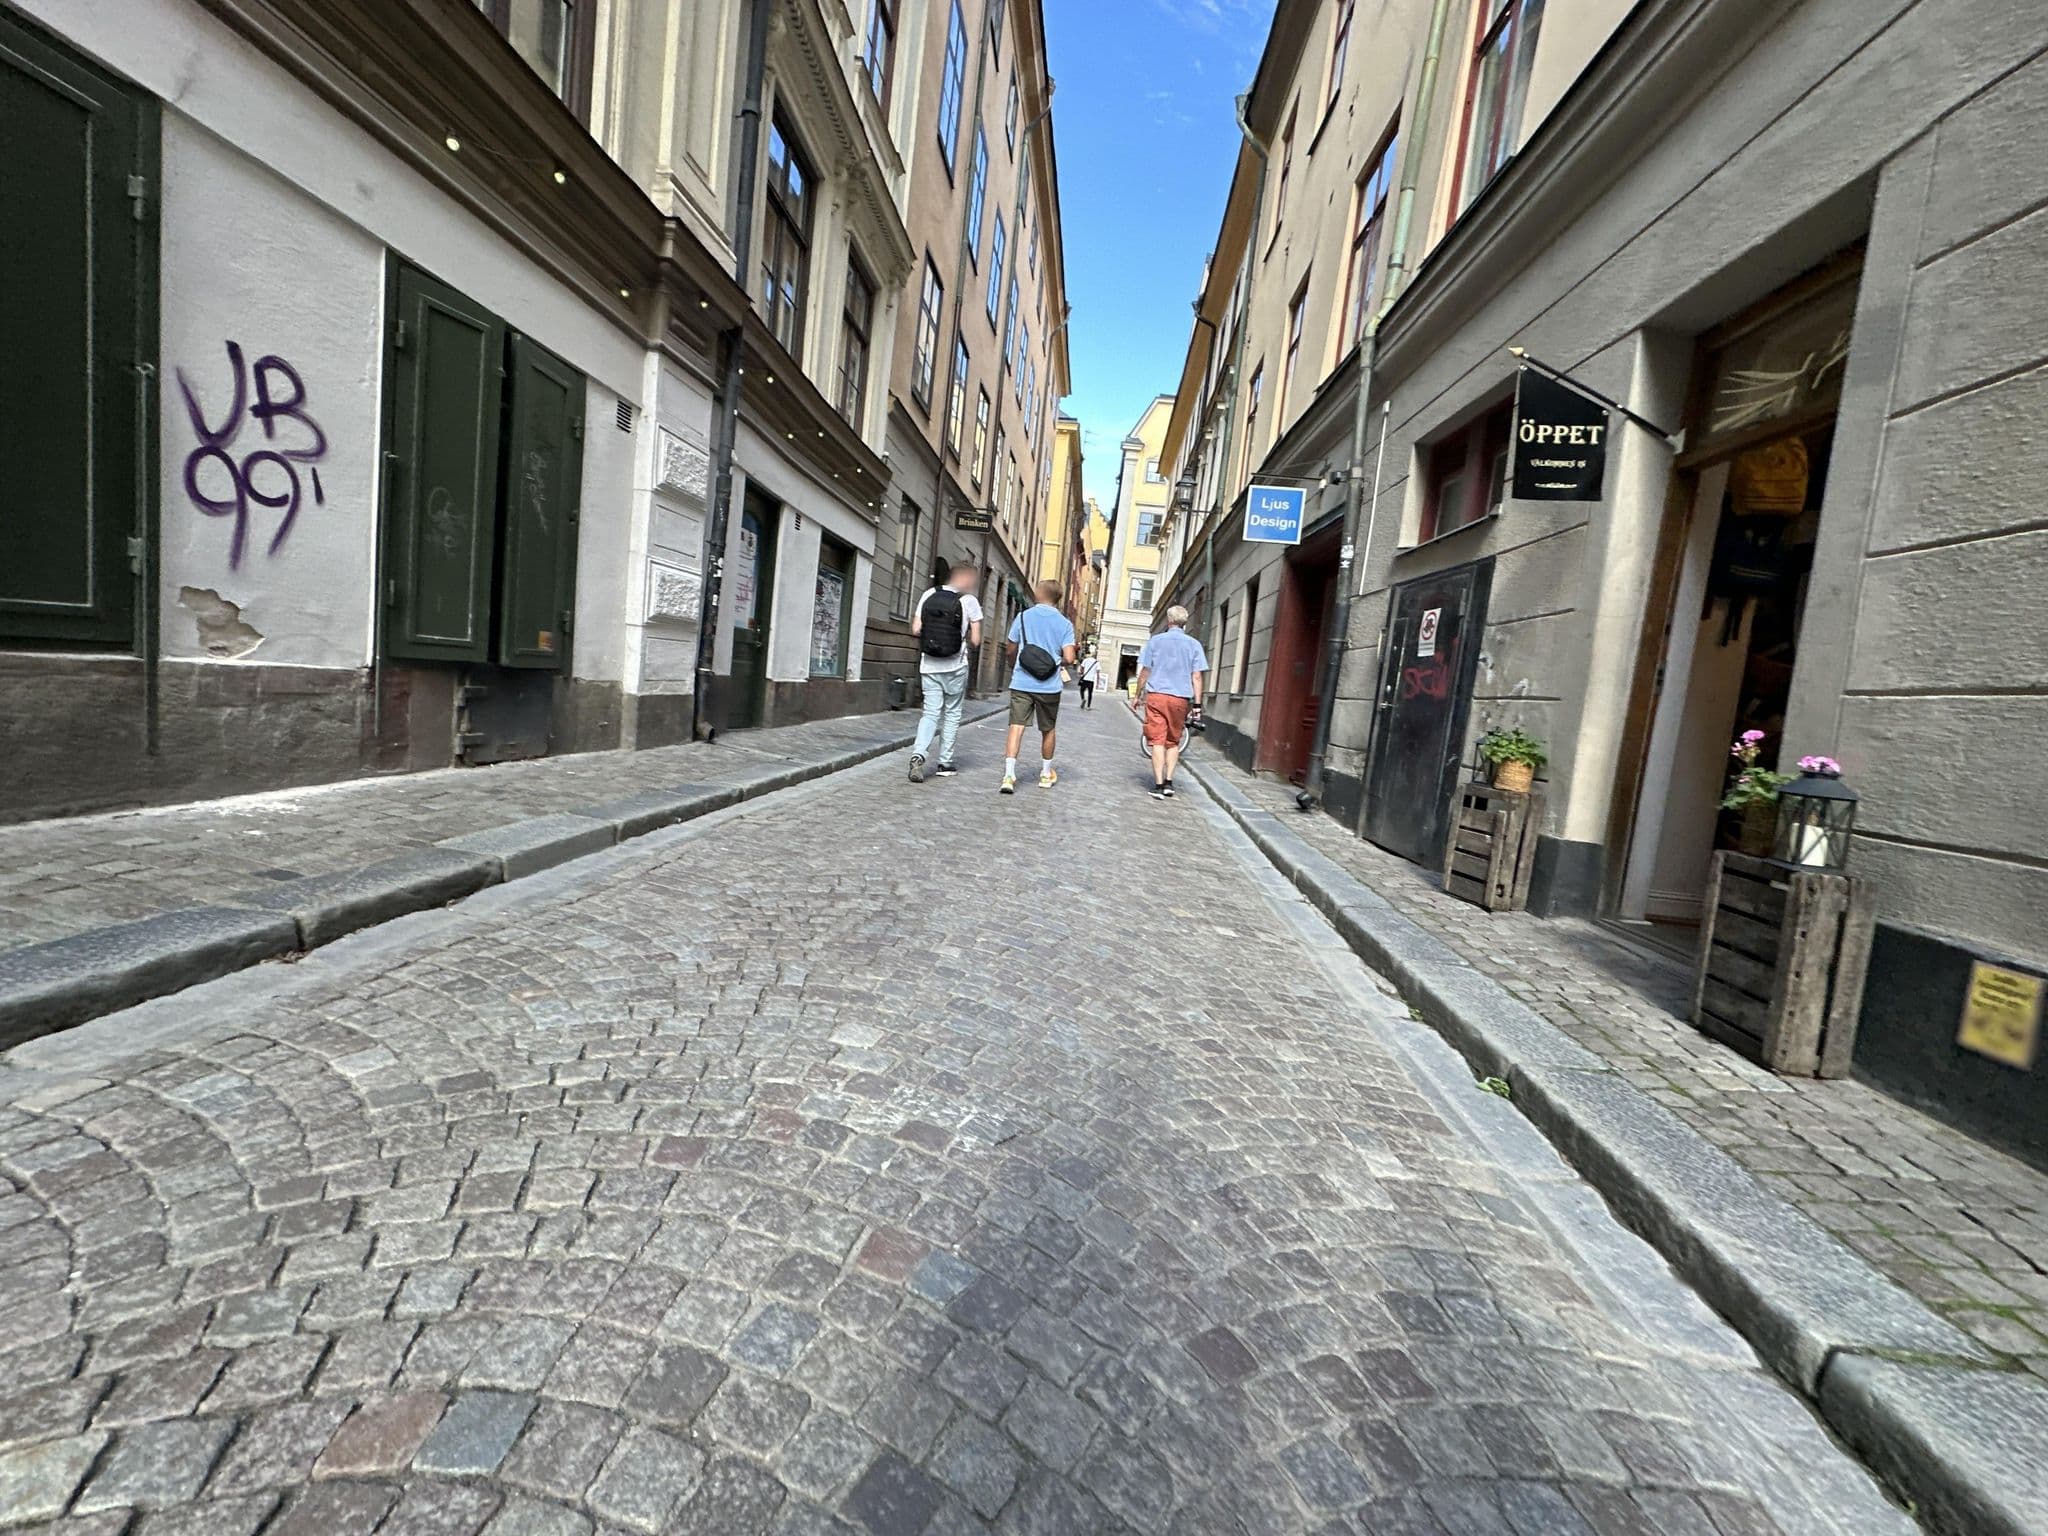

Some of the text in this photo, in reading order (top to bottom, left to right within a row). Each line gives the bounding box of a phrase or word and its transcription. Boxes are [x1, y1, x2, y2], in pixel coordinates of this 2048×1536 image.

[1520, 419, 1604, 445] ÖPPET
[1261, 497, 1290, 512] Ljus
[958, 517, 989, 529] Brinken
[1250, 514, 1297, 531] Design
